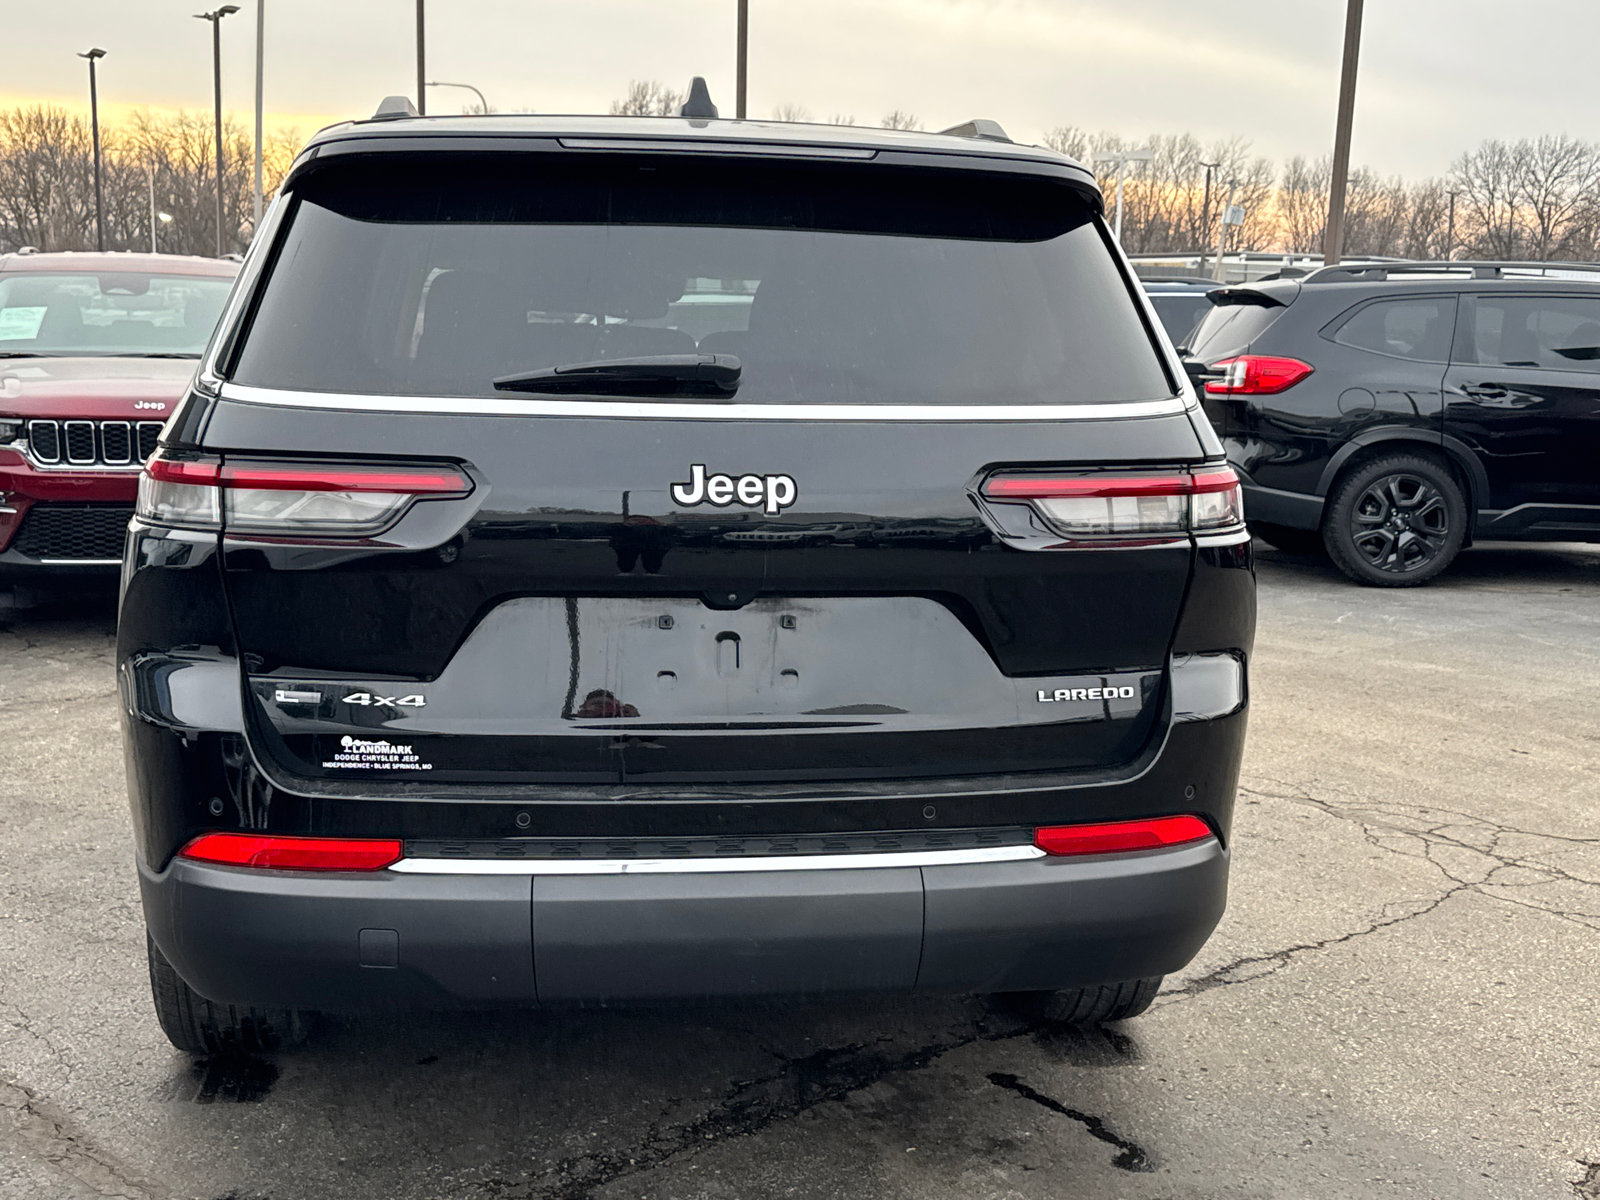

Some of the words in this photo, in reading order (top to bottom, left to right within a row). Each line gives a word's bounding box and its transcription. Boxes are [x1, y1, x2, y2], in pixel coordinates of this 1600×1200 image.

[133, 400, 166, 411] Jeep
[671, 464, 797, 515] Jeep
[342, 692, 427, 707] 4x4
[1037, 686, 1135, 702] LAREDO
[352, 745, 413, 755] LANDMARK
[401, 755, 420, 763] JEEP
[373, 762, 391, 770] BLUE
